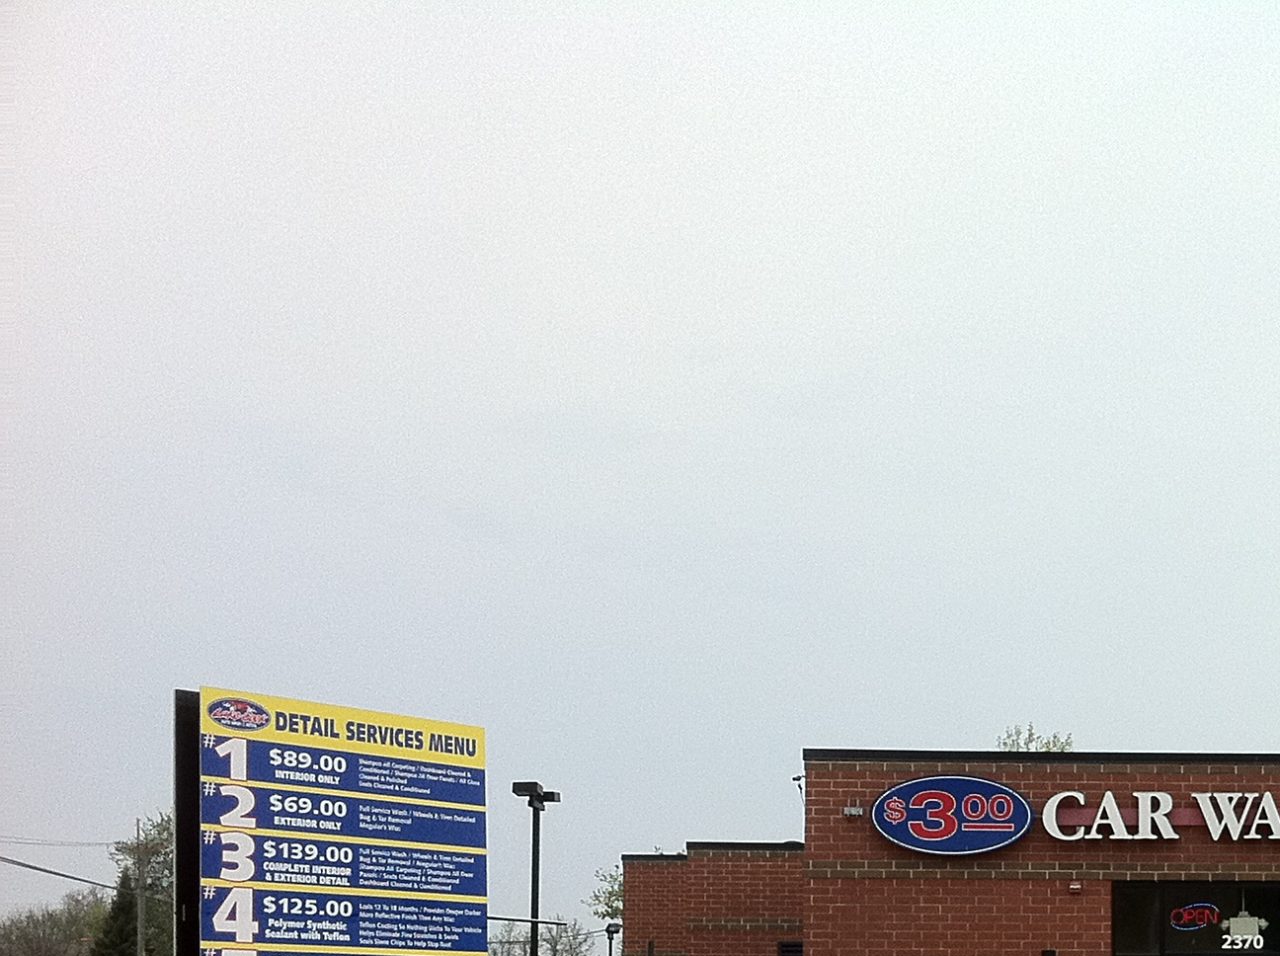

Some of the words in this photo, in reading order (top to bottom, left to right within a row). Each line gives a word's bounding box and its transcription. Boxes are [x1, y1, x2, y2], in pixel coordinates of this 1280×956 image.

[275, 711, 340, 740] DETAIL
[345, 721, 424, 750] SERVICES
[429, 733, 477, 757] MENU
[203, 734, 248, 781] #1
[269, 748, 347, 773] $89.00
[275, 769, 316, 782] INTERIOR
[317, 774, 340, 785] ONLY
[203, 782, 256, 828] #2
[269, 794, 348, 817] $69.00
[274, 816, 317, 828] EXTERIOR
[319, 820, 342, 830] ONLY
[1041, 791, 1179, 842] CAR
[203, 830, 256, 882] #3
[263, 840, 353, 863] $139.00
[263, 861, 310, 873] COMPLETE
[312, 865, 352, 876] INTERIOR
[265, 872, 272, 881] &
[273, 873, 317, 884] EXTERIOR
[319, 876, 350, 886] DETAIL
[203, 886, 259, 943] #4
[263, 895, 353, 917] $125.00
[1170, 908, 1218, 925] OPEN
[265, 929, 298, 939] Sealant
[300, 930, 321, 940] with
[322, 931, 350, 941] Teflon
[268, 918, 305, 930] Polymer
[307, 920, 347, 931] Synthetic
[1221, 934, 1264, 949] 2370
